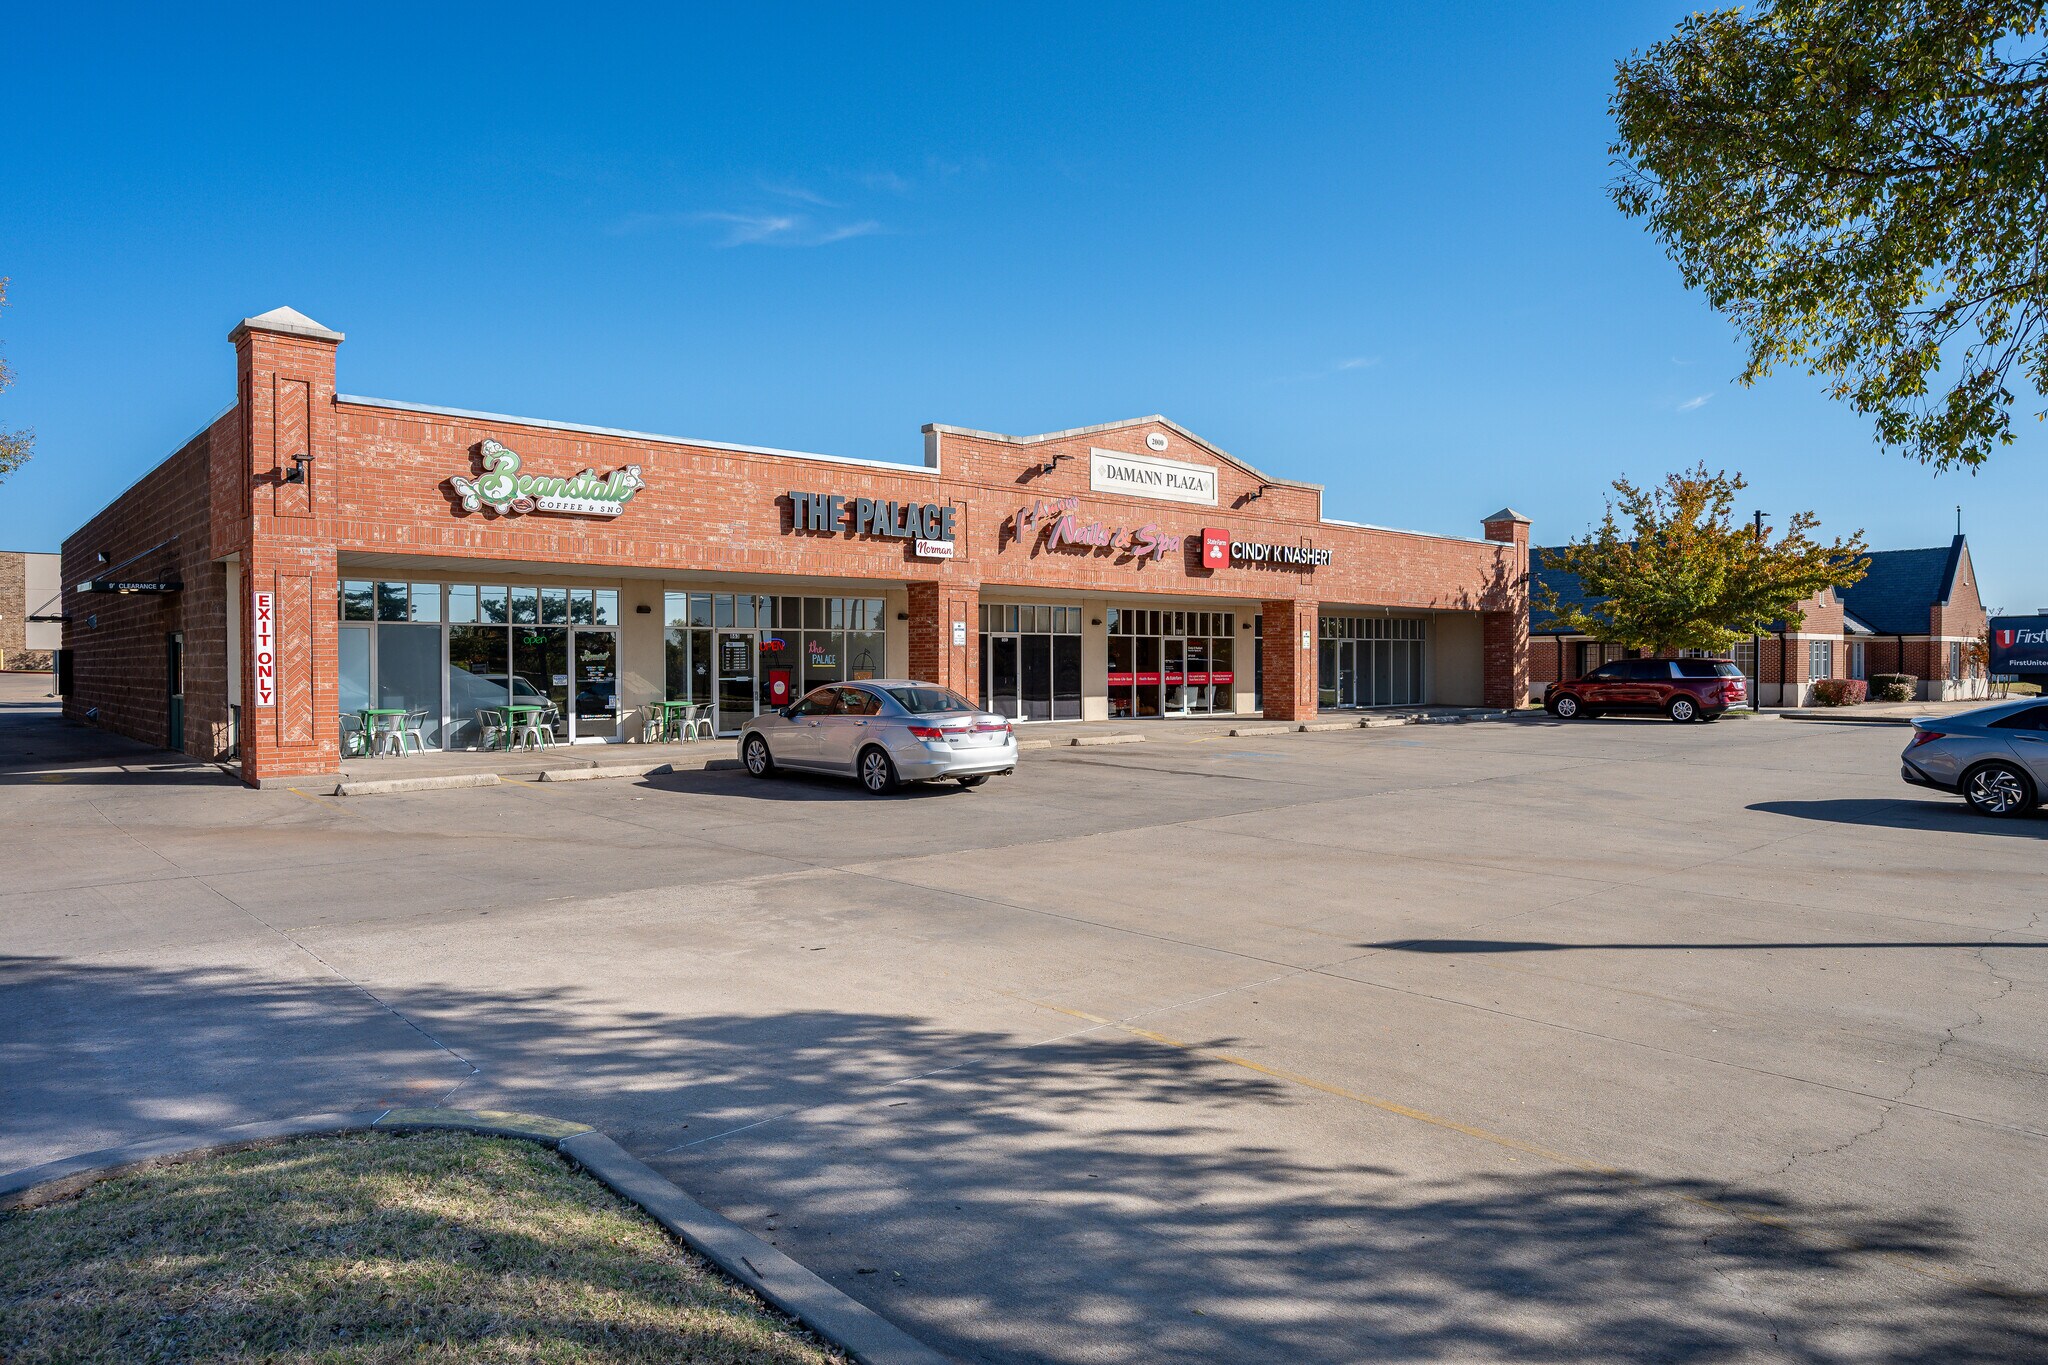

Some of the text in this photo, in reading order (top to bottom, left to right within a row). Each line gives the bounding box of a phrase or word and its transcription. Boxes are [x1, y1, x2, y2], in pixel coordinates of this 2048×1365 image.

[1151, 438, 1165, 446] 2000
[478, 449, 637, 503] Beanstalk
[1106, 464, 1204, 492] DAMANN PLAZA
[539, 501, 583, 511] COFFEE
[600, 506, 622, 514] SNO
[788, 491, 957, 541] THE PALACE
[1047, 515, 1181, 561] Nails & Spa
[917, 541, 953, 555] Norman
[1231, 542, 1333, 566] CINDY K NASHERT
[523, 635, 547, 646] open
[759, 640, 785, 651] OPEN
[808, 640, 826, 654] the
[257, 595, 272, 704] EXIT ONLY
[812, 654, 836, 664] PALACE
